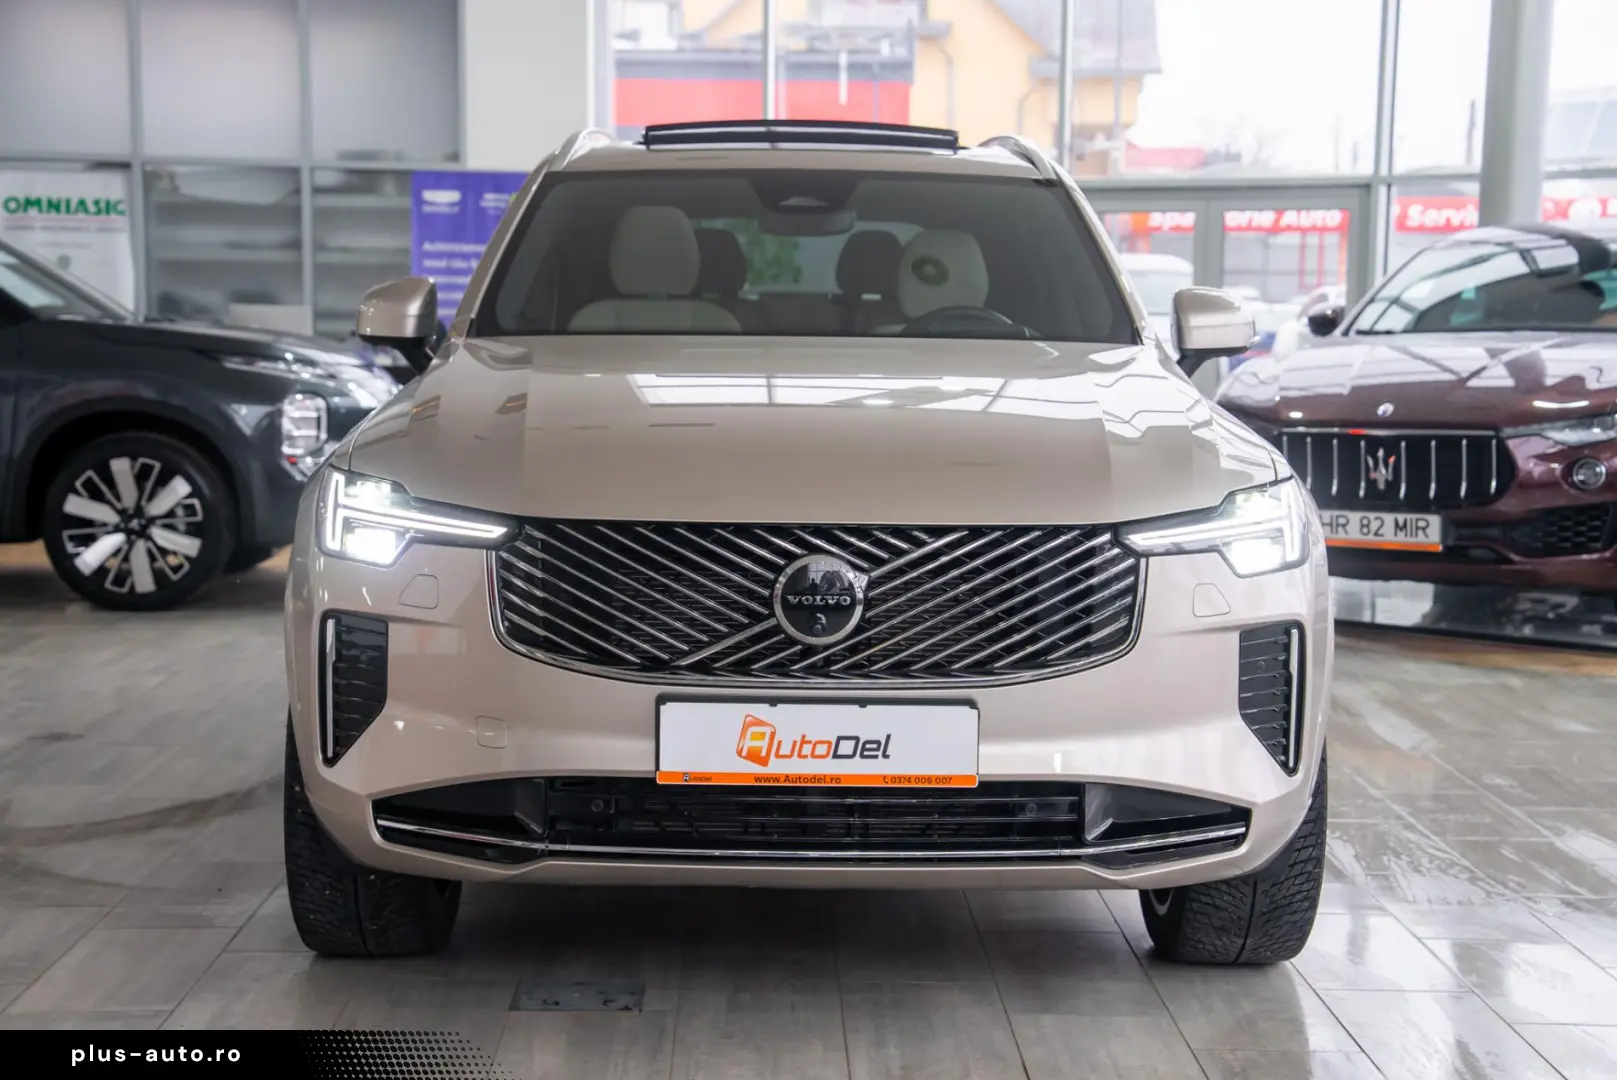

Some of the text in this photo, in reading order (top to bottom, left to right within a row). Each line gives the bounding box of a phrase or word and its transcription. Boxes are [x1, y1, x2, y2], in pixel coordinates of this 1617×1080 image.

[1359, 515, 1385, 537] 82
[1393, 517, 1430, 538] MIR
[786, 595, 852, 606] VOLVO
[737, 717, 892, 764] AutoDel
[753, 774, 842, 785] www.Autodel.ro
[890, 776, 953, 785] 0374 006 007
